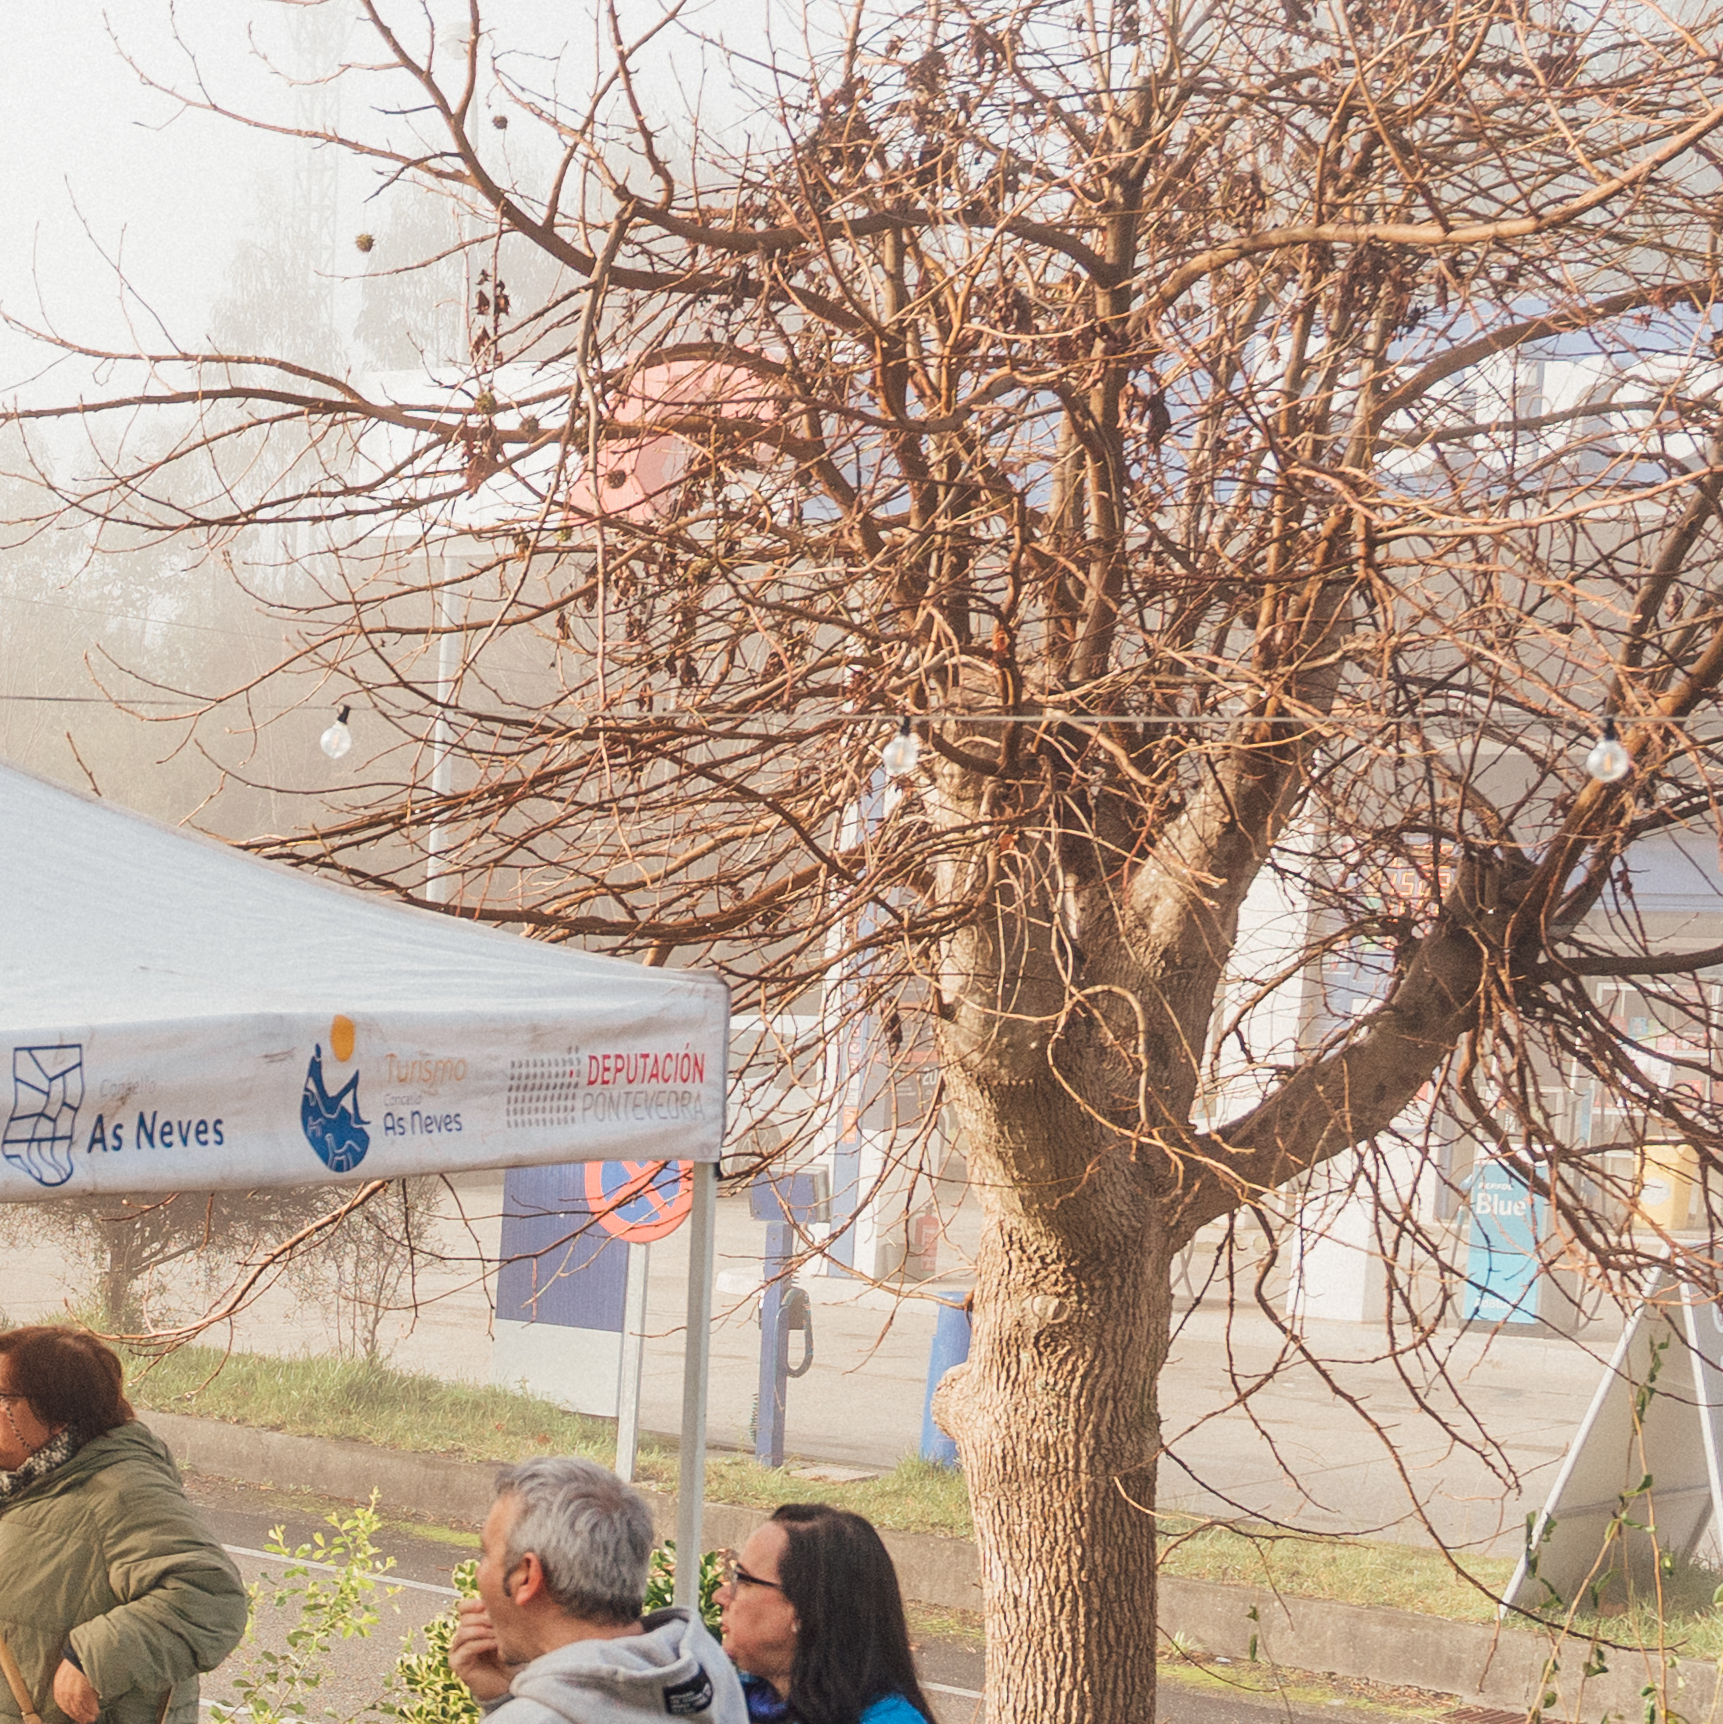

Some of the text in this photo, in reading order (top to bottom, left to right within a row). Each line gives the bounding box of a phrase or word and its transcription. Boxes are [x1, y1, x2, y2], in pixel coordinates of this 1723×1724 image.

[385, 1053, 467, 1084] Turismo
[587, 1043, 705, 1087] DEPUTACIÓN
[581, 1089, 705, 1123] PONTEVEDRA
[87, 1110, 224, 1153] As Neves
[384, 1109, 463, 1137] As Neves
[1475, 1192, 1528, 1217] Blue
